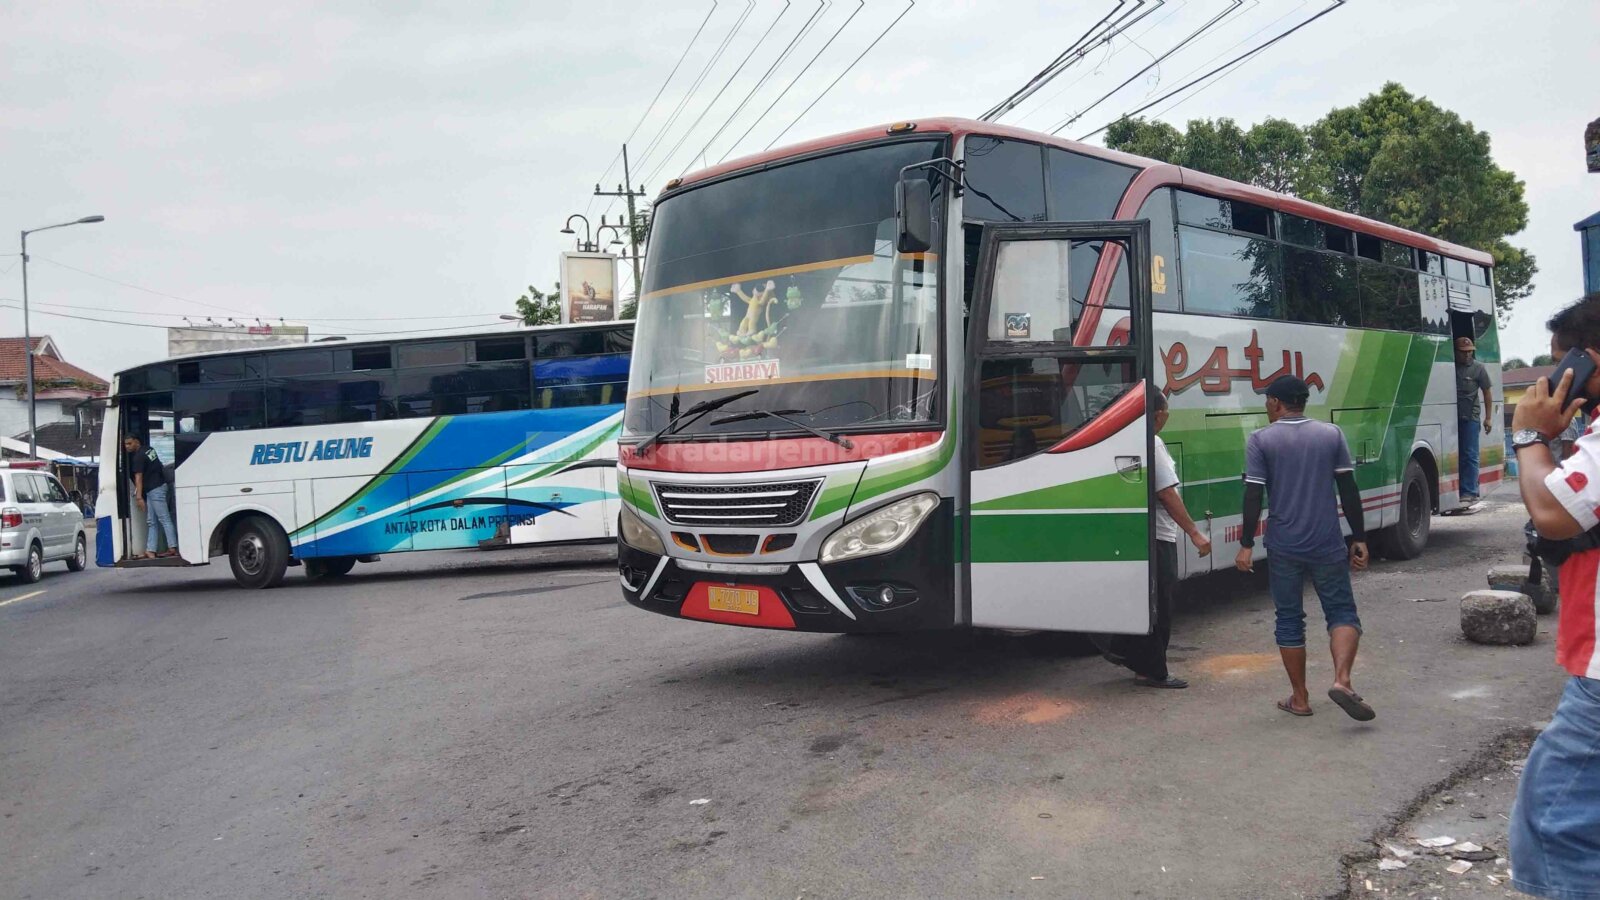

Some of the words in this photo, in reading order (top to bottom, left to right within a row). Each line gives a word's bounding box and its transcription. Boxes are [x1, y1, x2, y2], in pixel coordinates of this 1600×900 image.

[706, 362, 778, 382] SURABAYA
[250, 441, 308, 465] RESTU
[308, 437, 374, 461] AGUNG
[385, 520, 418, 535] ANTAR
[420, 518, 447, 533] KOTA
[451, 516, 486, 530] DALAM
